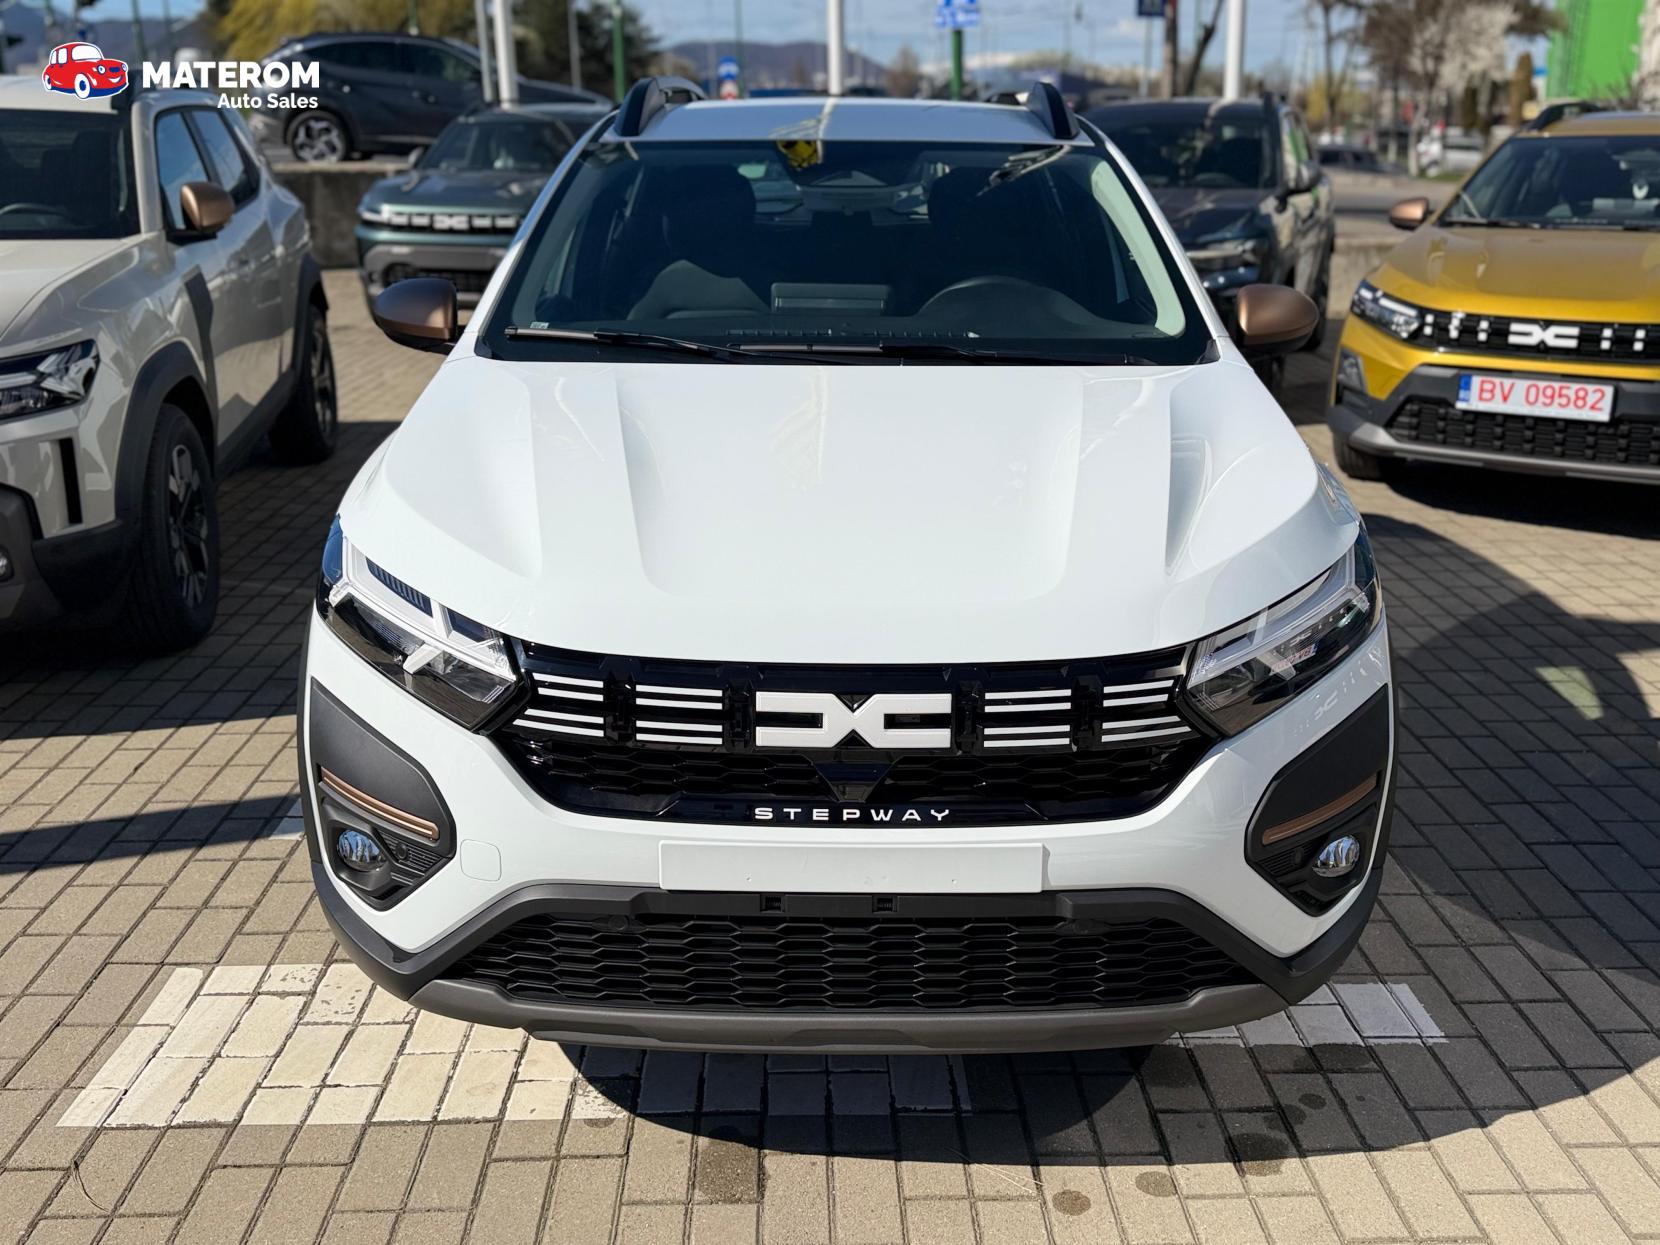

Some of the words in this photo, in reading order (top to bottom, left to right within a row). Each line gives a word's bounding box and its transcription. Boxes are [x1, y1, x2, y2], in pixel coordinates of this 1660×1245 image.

[1478, 378, 1515, 403] BV
[1524, 383, 1606, 412] 09582
[754, 807, 950, 821] STEPWAY
